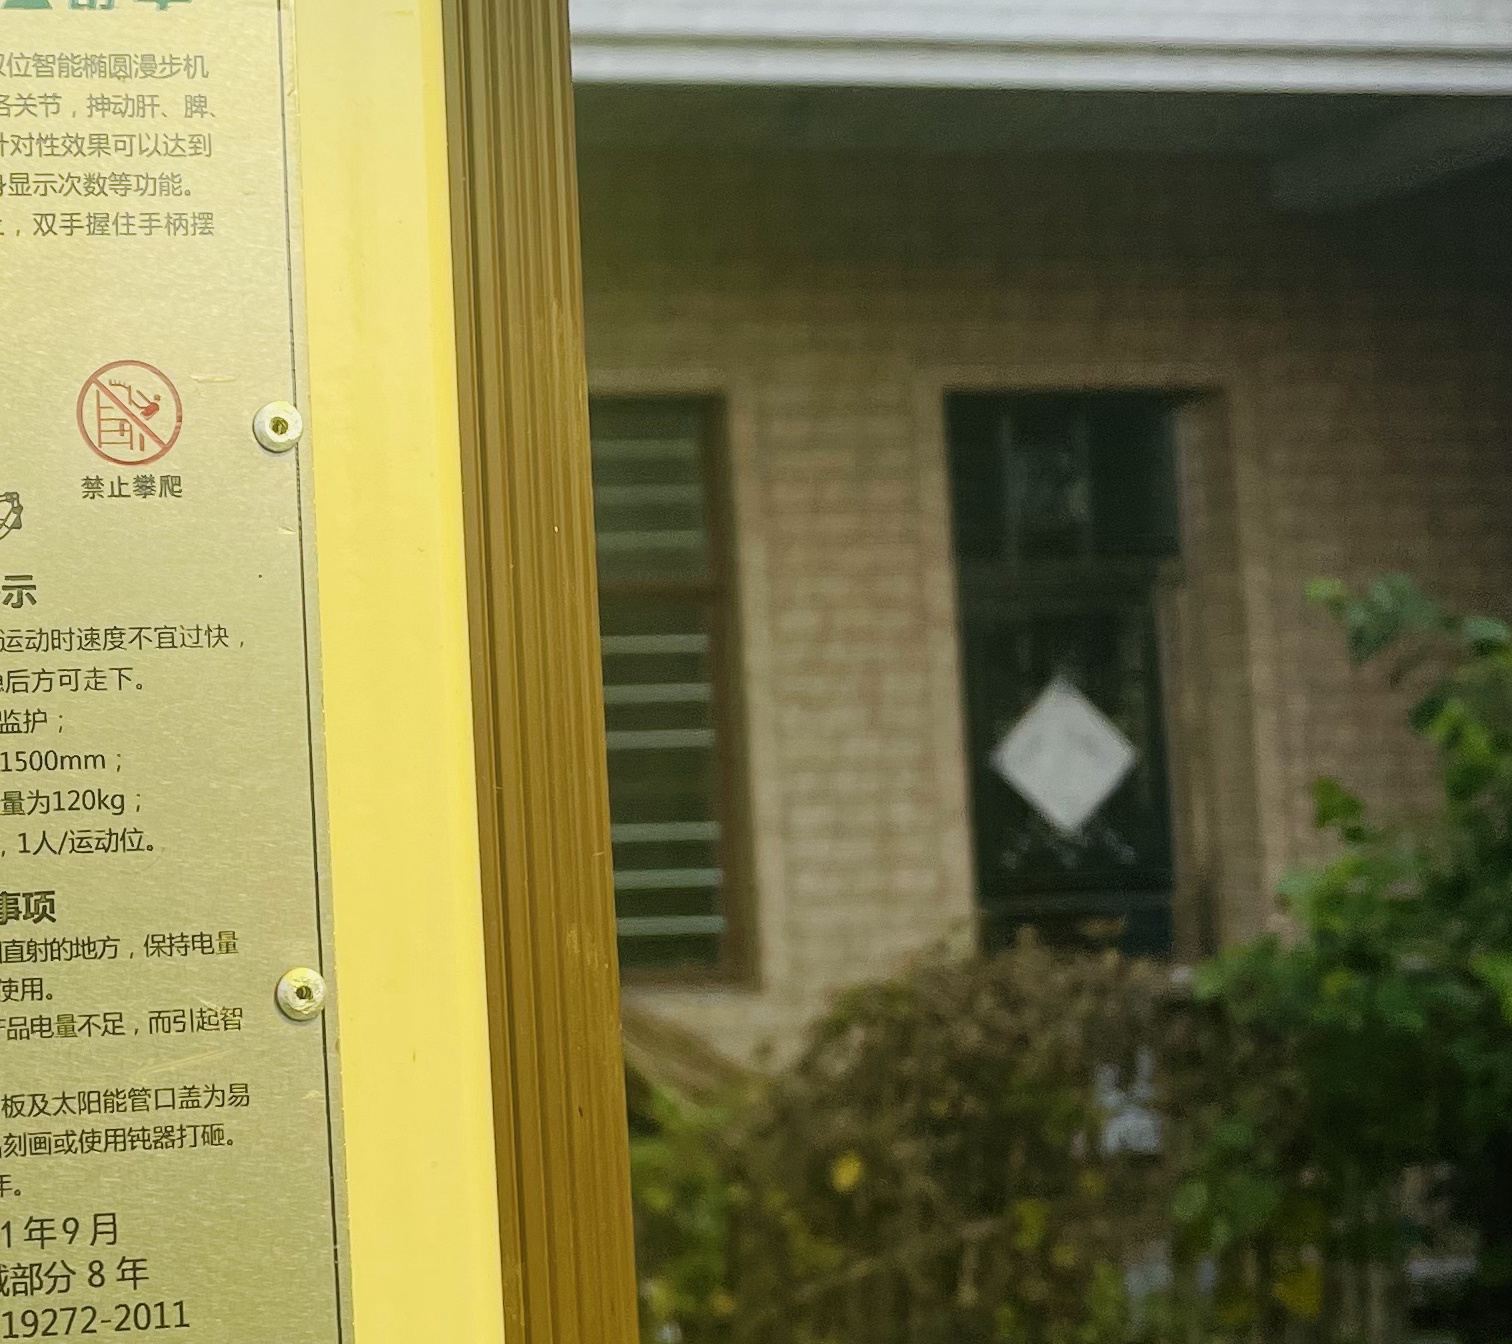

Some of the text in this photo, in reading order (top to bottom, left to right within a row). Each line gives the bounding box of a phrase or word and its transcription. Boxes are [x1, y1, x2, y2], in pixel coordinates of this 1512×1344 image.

[81, 474, 183, 501] 禁止攀爬
[3, 1300, 190, 1341] 19272-2011
